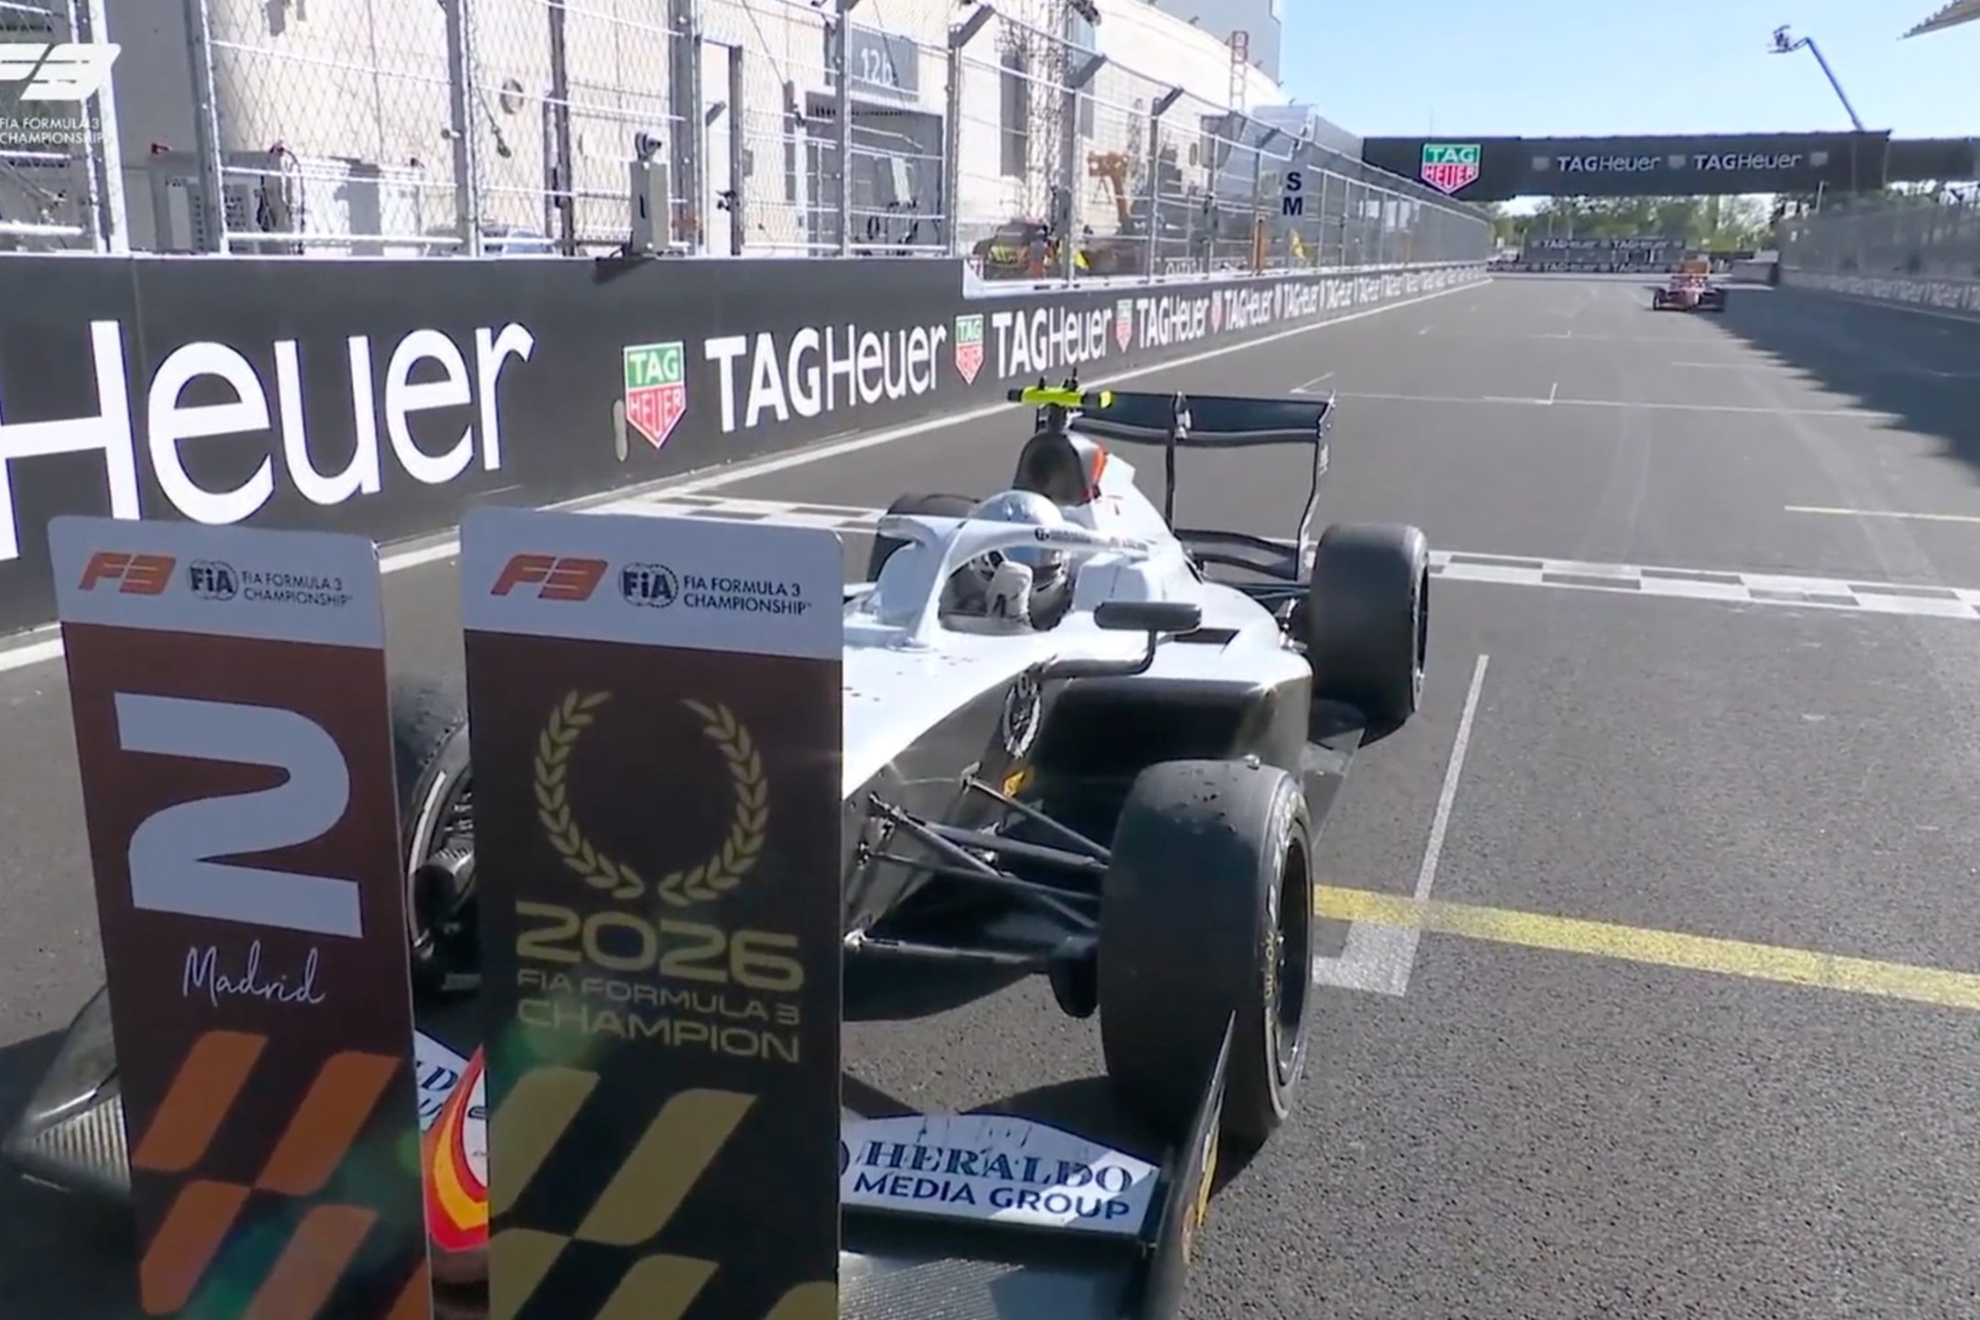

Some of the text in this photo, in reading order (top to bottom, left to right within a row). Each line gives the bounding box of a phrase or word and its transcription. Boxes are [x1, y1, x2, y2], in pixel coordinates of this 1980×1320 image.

[1425, 165, 1476, 189] HEUER
[1428, 148, 1475, 163] TAG
[1286, 172, 1302, 192] S
[1282, 196, 1303, 216] M
[629, 350, 679, 385] TAG
[629, 385, 683, 442] HEUER
[78, 551, 177, 596] F3
[242, 570, 343, 592] FIA FORMULA 3
[490, 554, 608, 601] F3
[684, 574, 801, 598] FIA FORMULA 3
[114, 691, 364, 938] 2
[516, 900, 805, 992] 2026
[183, 939, 326, 1008] Madrid
[517, 967, 800, 1026] FIA FORMULA 3
[517, 998, 800, 1064] CHAMPION
[863, 1140, 1134, 1193] HERALDO
[853, 1171, 1131, 1221] MEDIA GROUP
